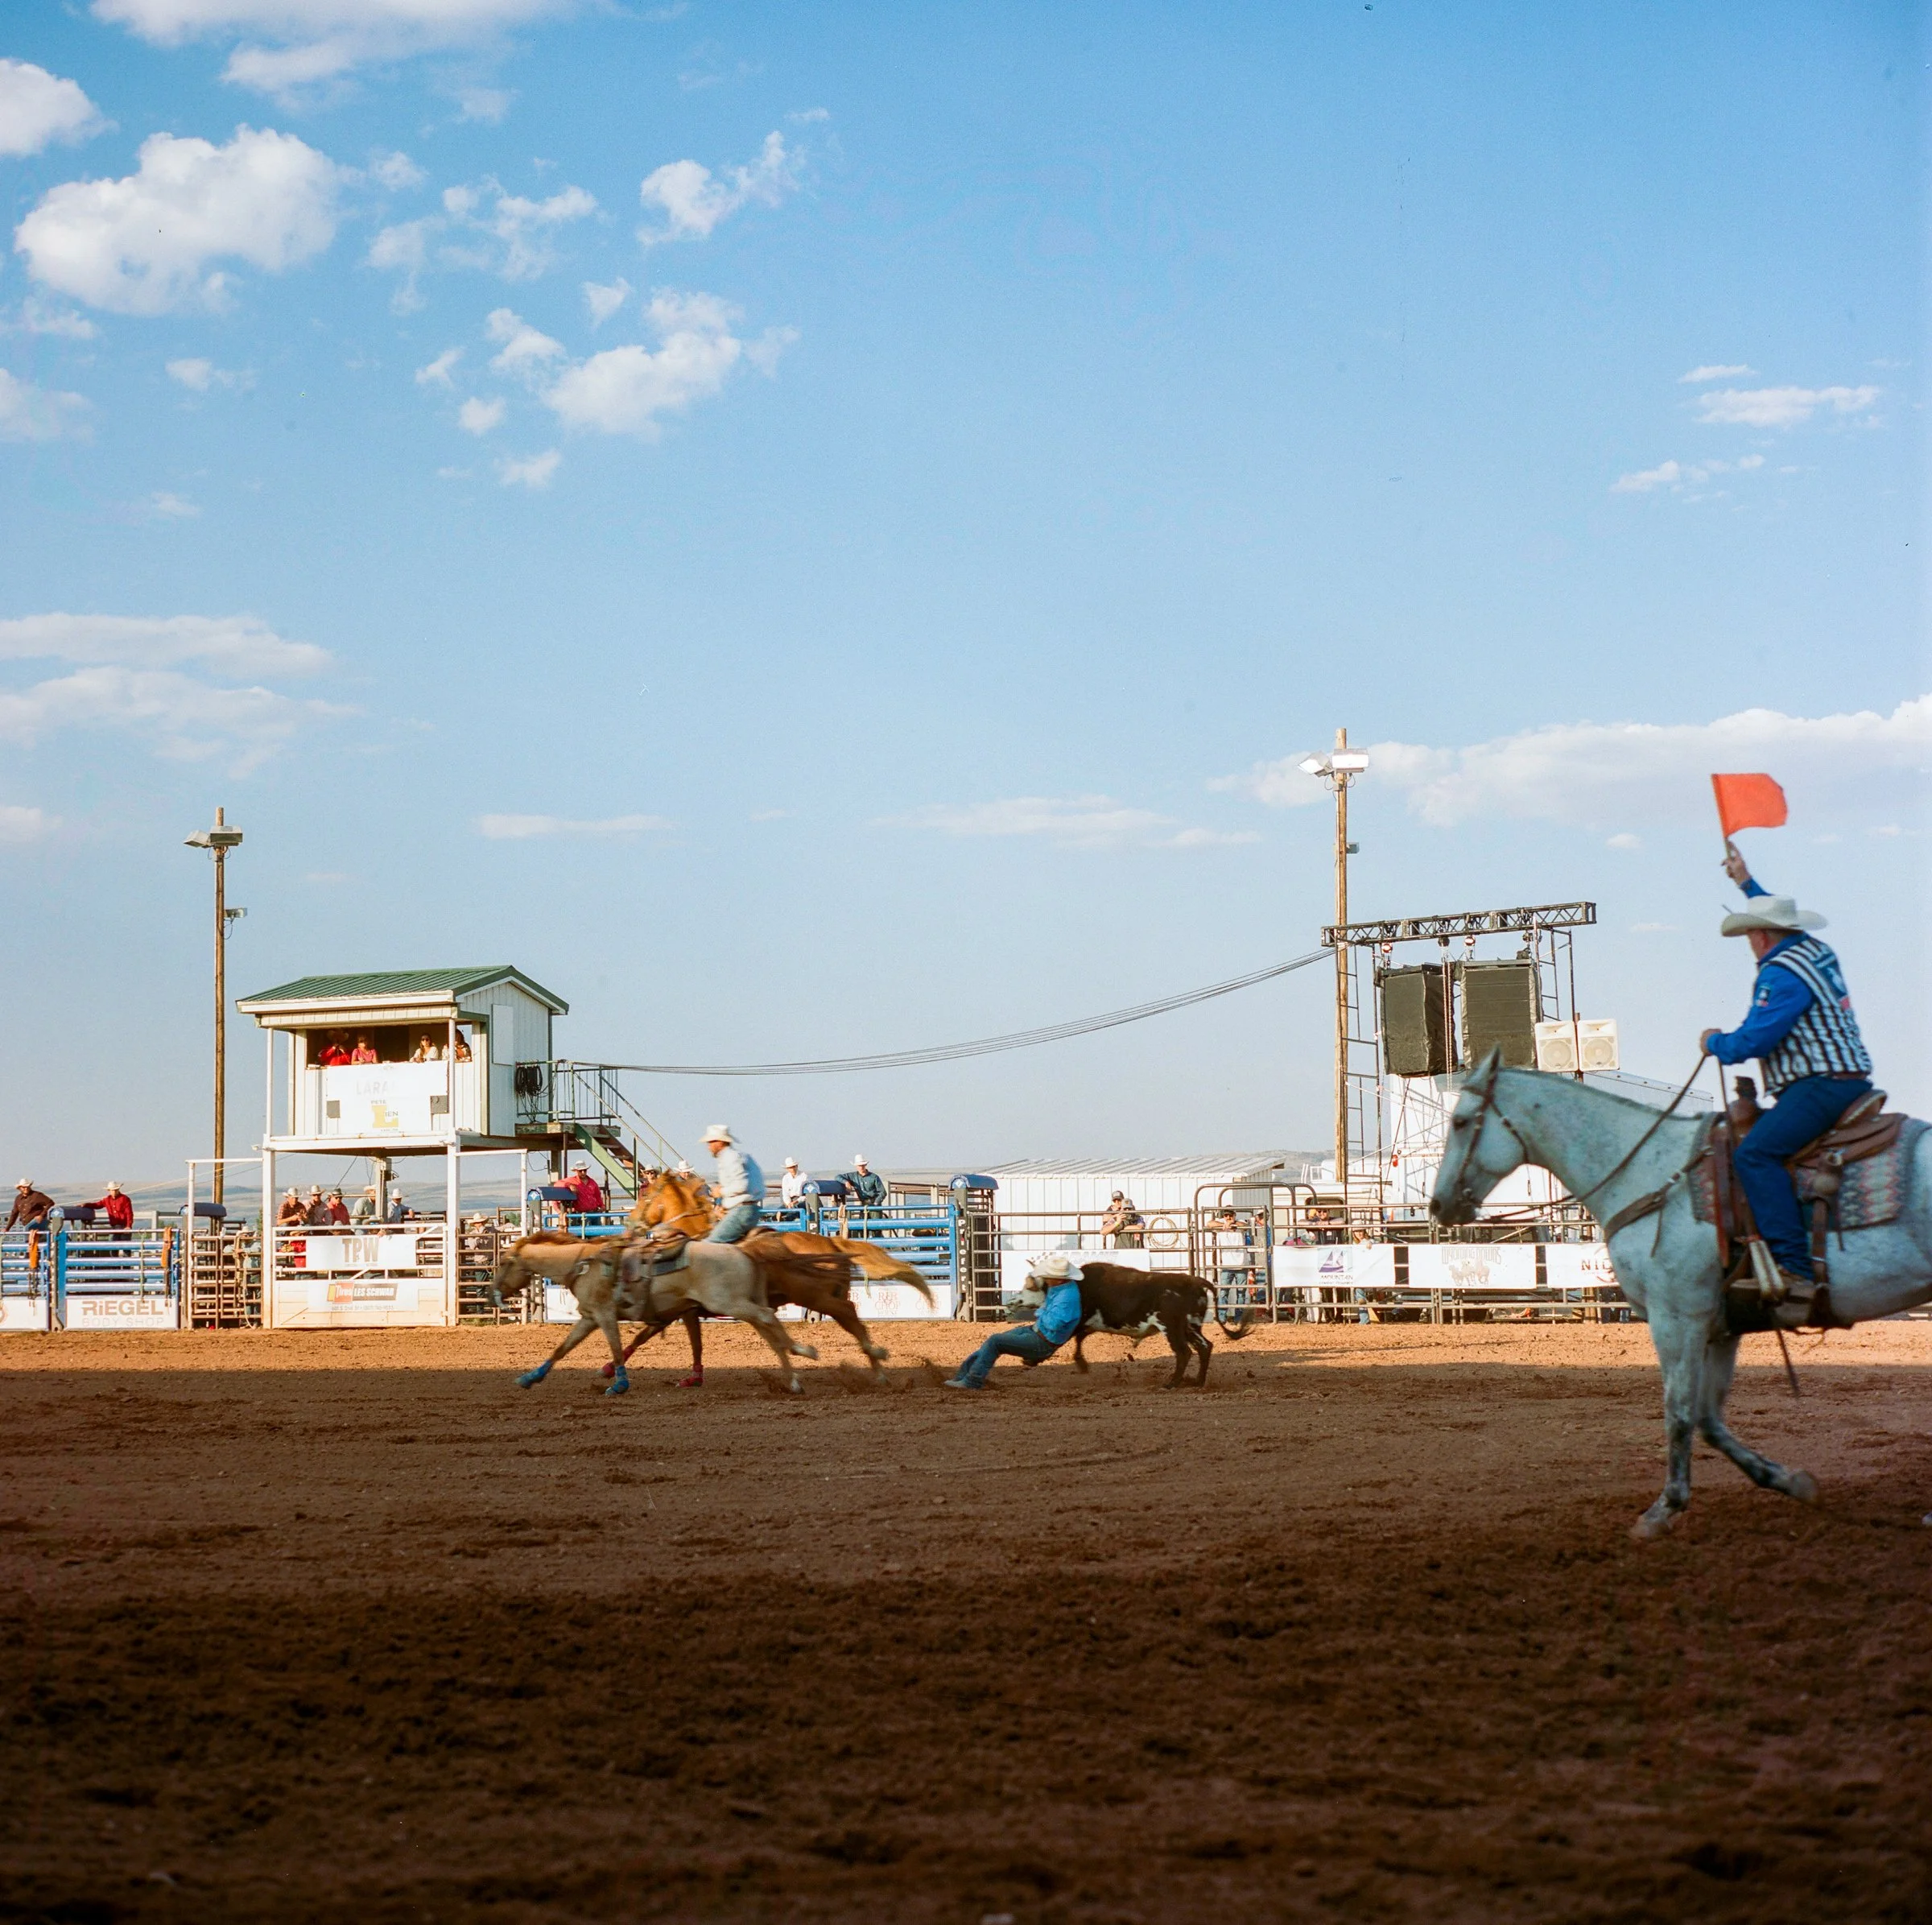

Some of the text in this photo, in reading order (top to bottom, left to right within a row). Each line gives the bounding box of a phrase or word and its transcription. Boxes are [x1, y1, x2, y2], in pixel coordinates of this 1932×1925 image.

[342, 1237, 378, 1262] TPW
[958, 1219, 967, 1291] Priefert
[354, 1287, 365, 1296] LES
[83, 1317, 164, 1327] BODY SHOP
